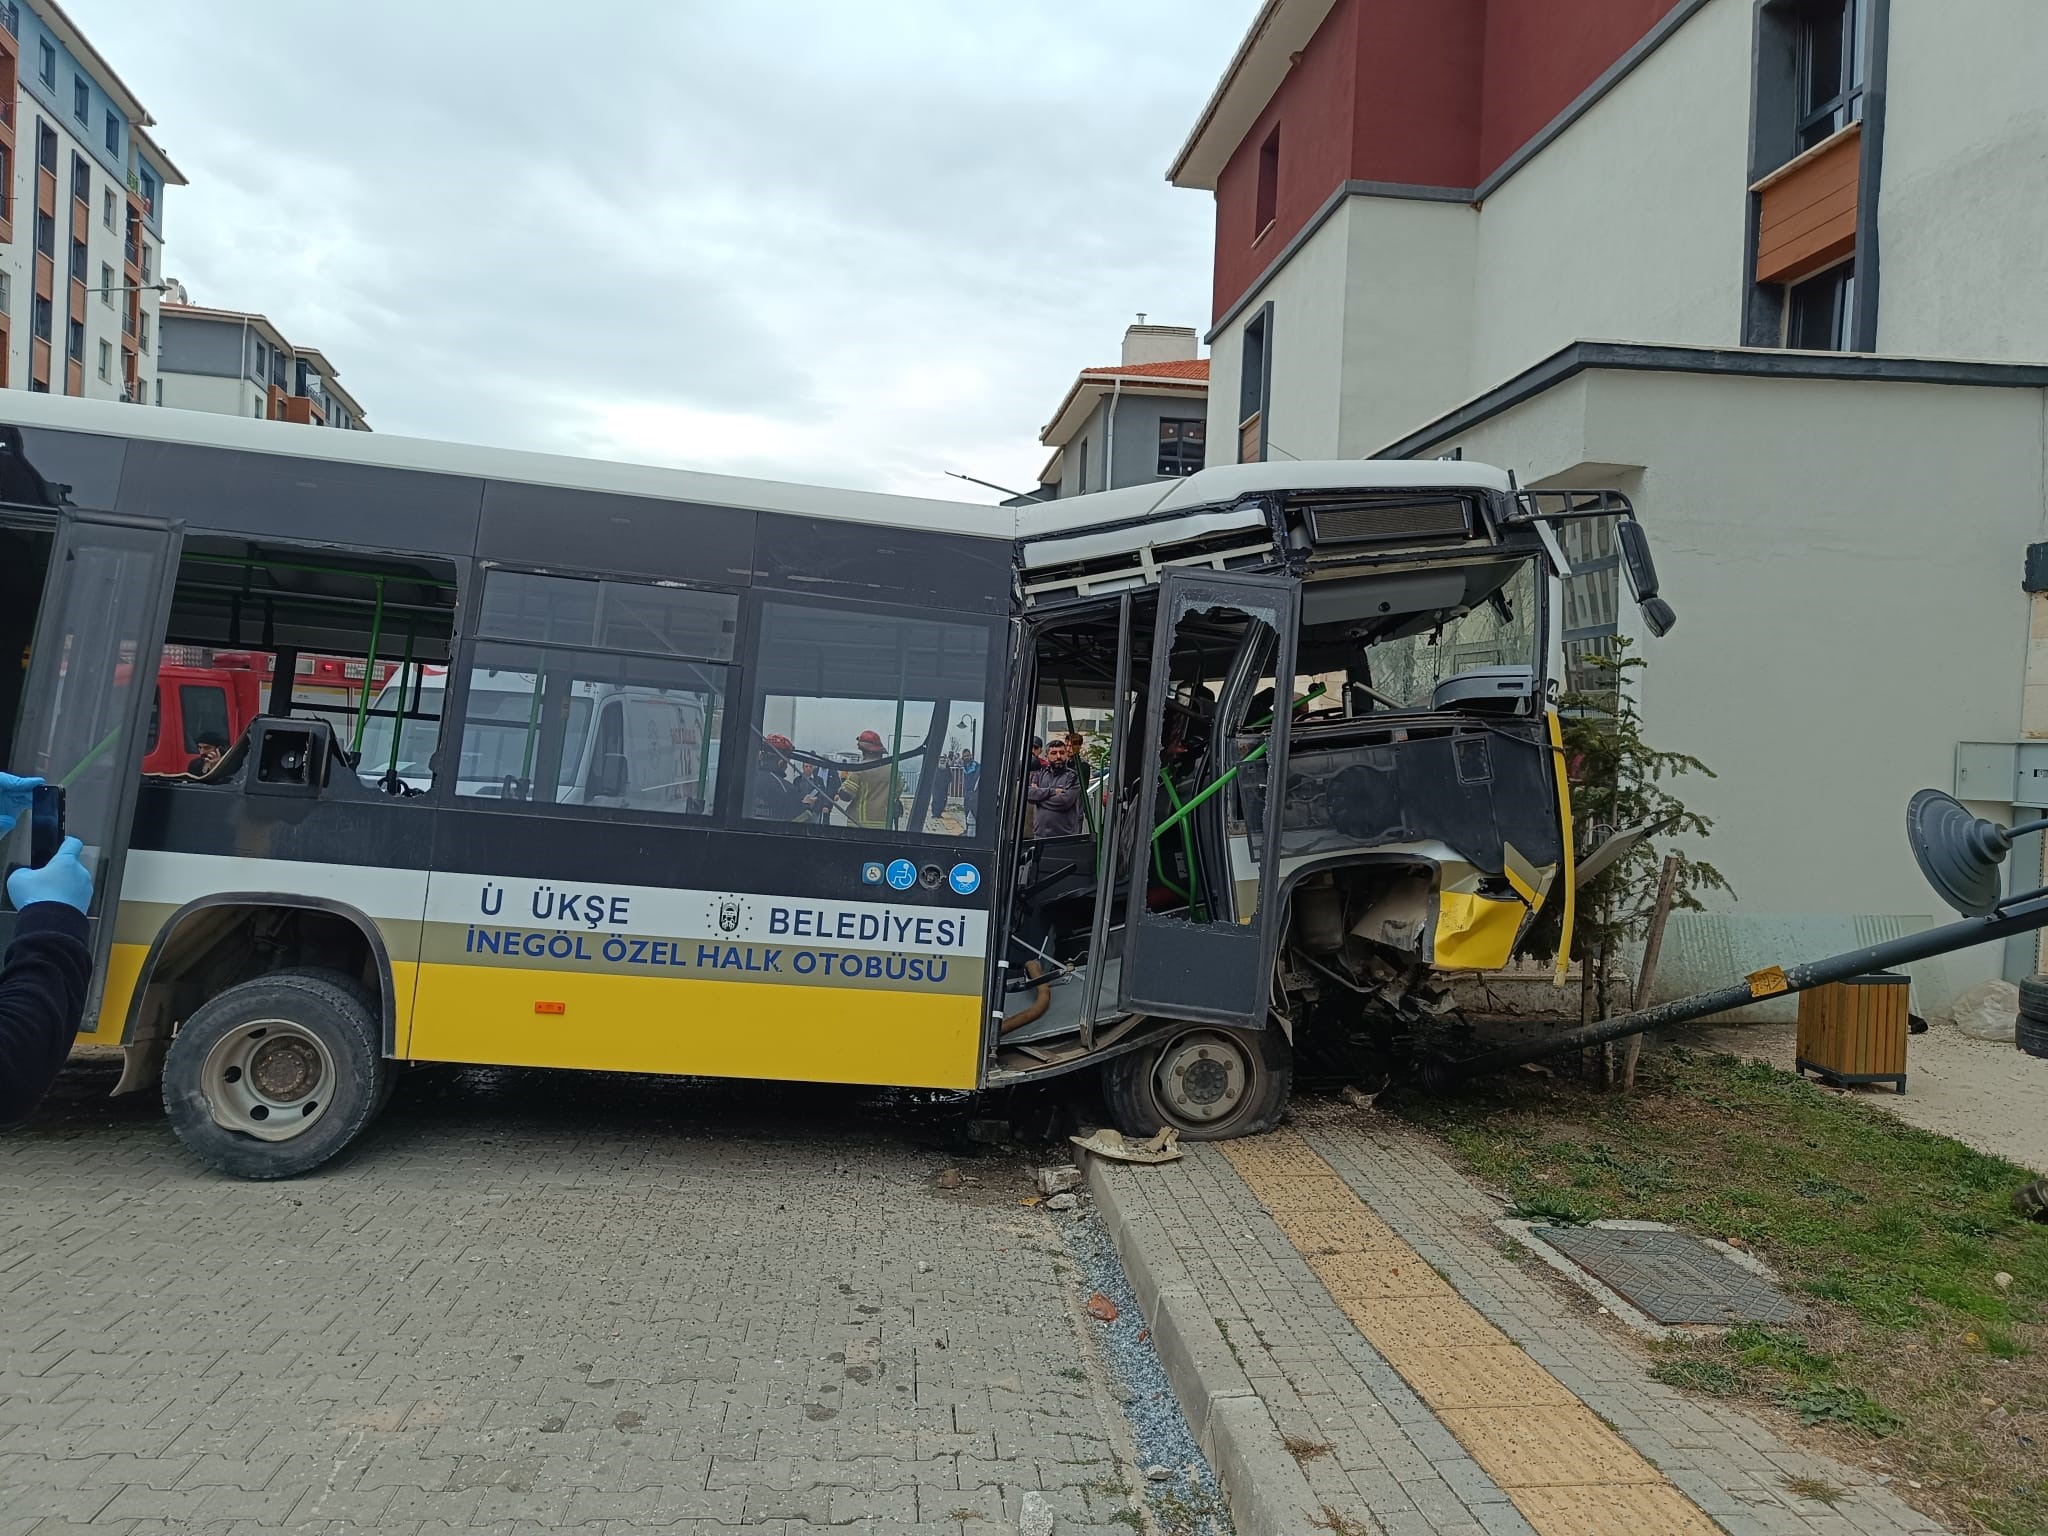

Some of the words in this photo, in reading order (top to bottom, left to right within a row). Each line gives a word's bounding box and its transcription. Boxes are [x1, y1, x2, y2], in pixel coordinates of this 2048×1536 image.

[1547, 682, 1559, 701] 4
[531, 885, 631, 930] ÜKŞE
[768, 907, 966, 947] BELEDİYESİ
[465, 923, 592, 961] İNEGÖL
[602, 932, 687, 967] ÖZEL
[696, 943, 783, 973] HALK
[792, 950, 949, 983] OTOBÜSÜ
